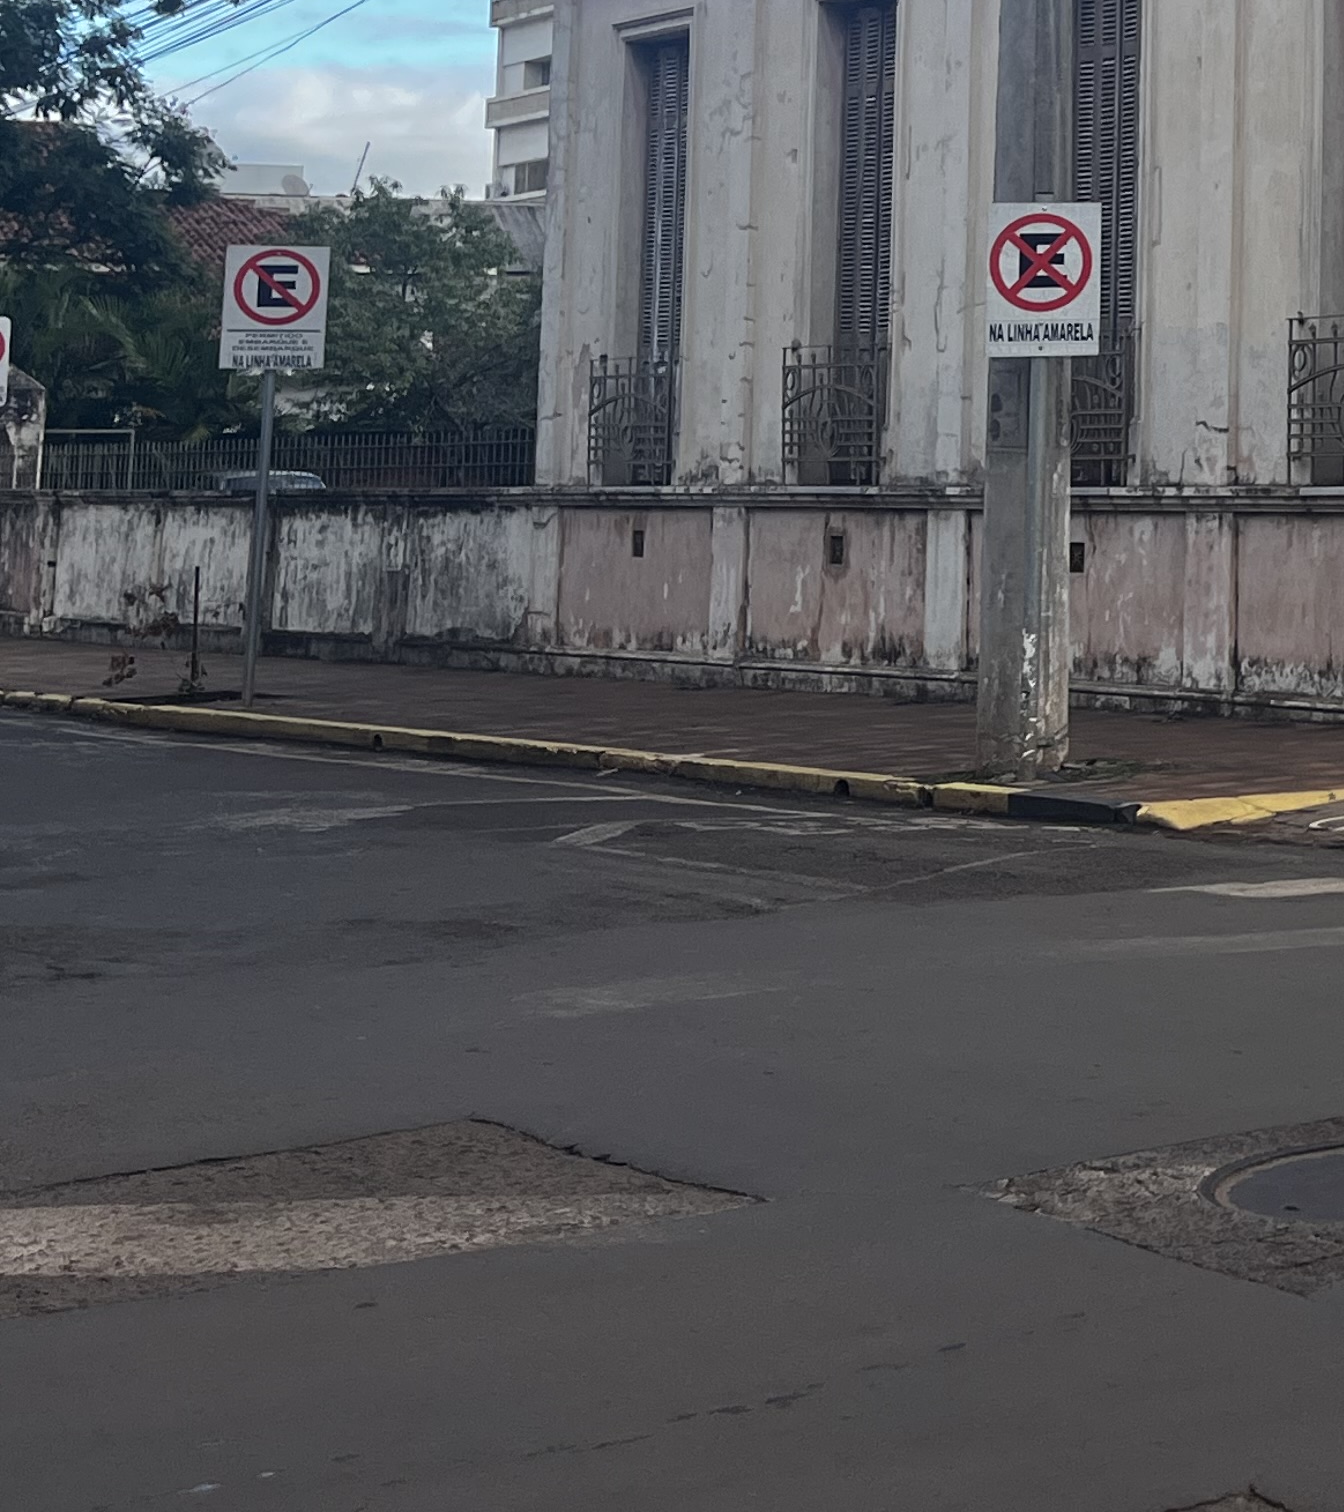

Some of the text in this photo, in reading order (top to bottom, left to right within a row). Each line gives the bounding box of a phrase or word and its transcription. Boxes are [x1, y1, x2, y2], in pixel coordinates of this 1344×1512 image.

[989, 323, 1093, 342] NA LINHA AMARELA
[232, 356, 244, 368] NA
[246, 355, 270, 368] LINHA
